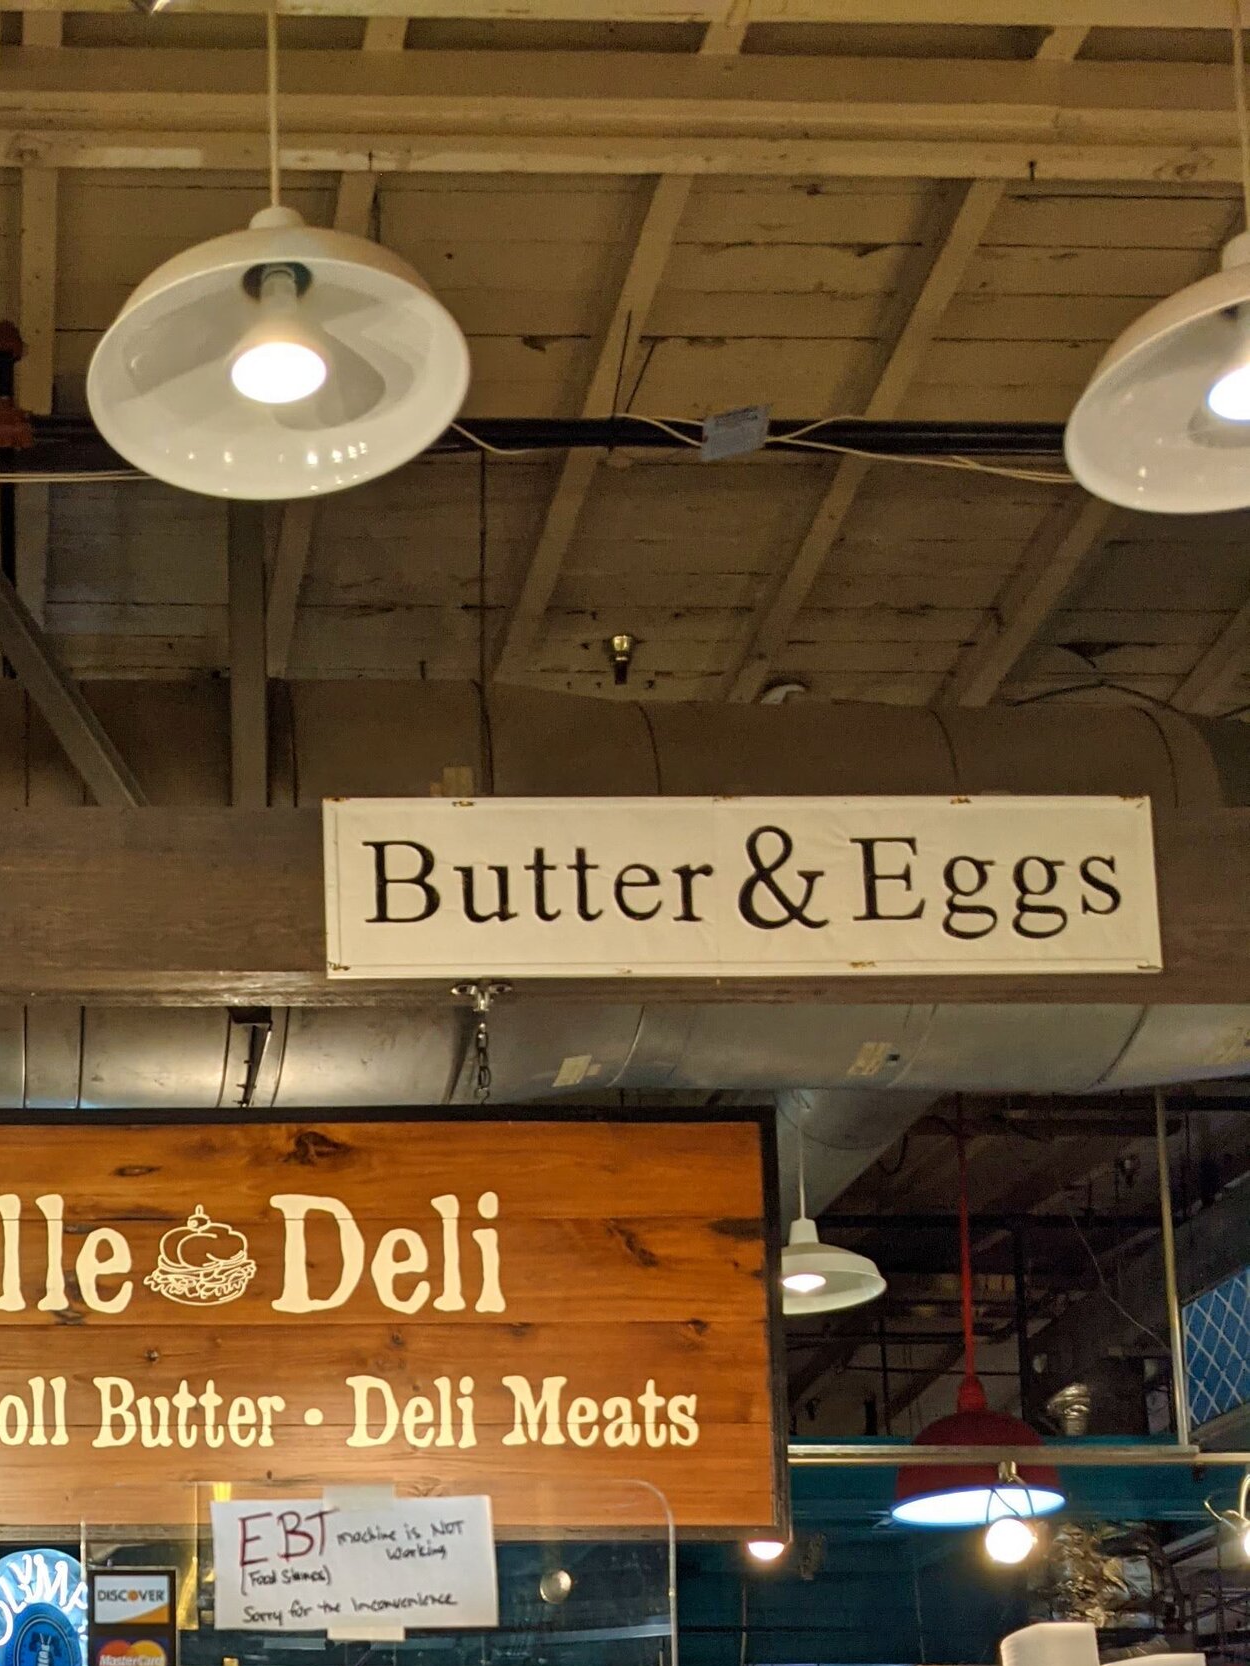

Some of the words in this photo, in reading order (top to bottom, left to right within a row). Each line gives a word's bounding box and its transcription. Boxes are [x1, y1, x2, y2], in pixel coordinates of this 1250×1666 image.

[362, 839, 714, 924] Butter
[737, 825, 830, 930] &
[851, 836, 1123, 941] Eggs
[269, 1190, 507, 1315] Deli
[93, 1376, 286, 1449] Butter
[345, 1374, 479, 1449] Deli
[501, 1375, 700, 1449] Meats
[238, 1508, 340, 1567] EBT
[336, 1525, 397, 1546] machine
[402, 1522, 422, 1541] is
[430, 1519, 466, 1536] NOT
[97, 1588, 165, 1604] DISCOVER
[242, 1606, 284, 1629] Sorry
[289, 1600, 311, 1619] for
[317, 1599, 342, 1614] the
